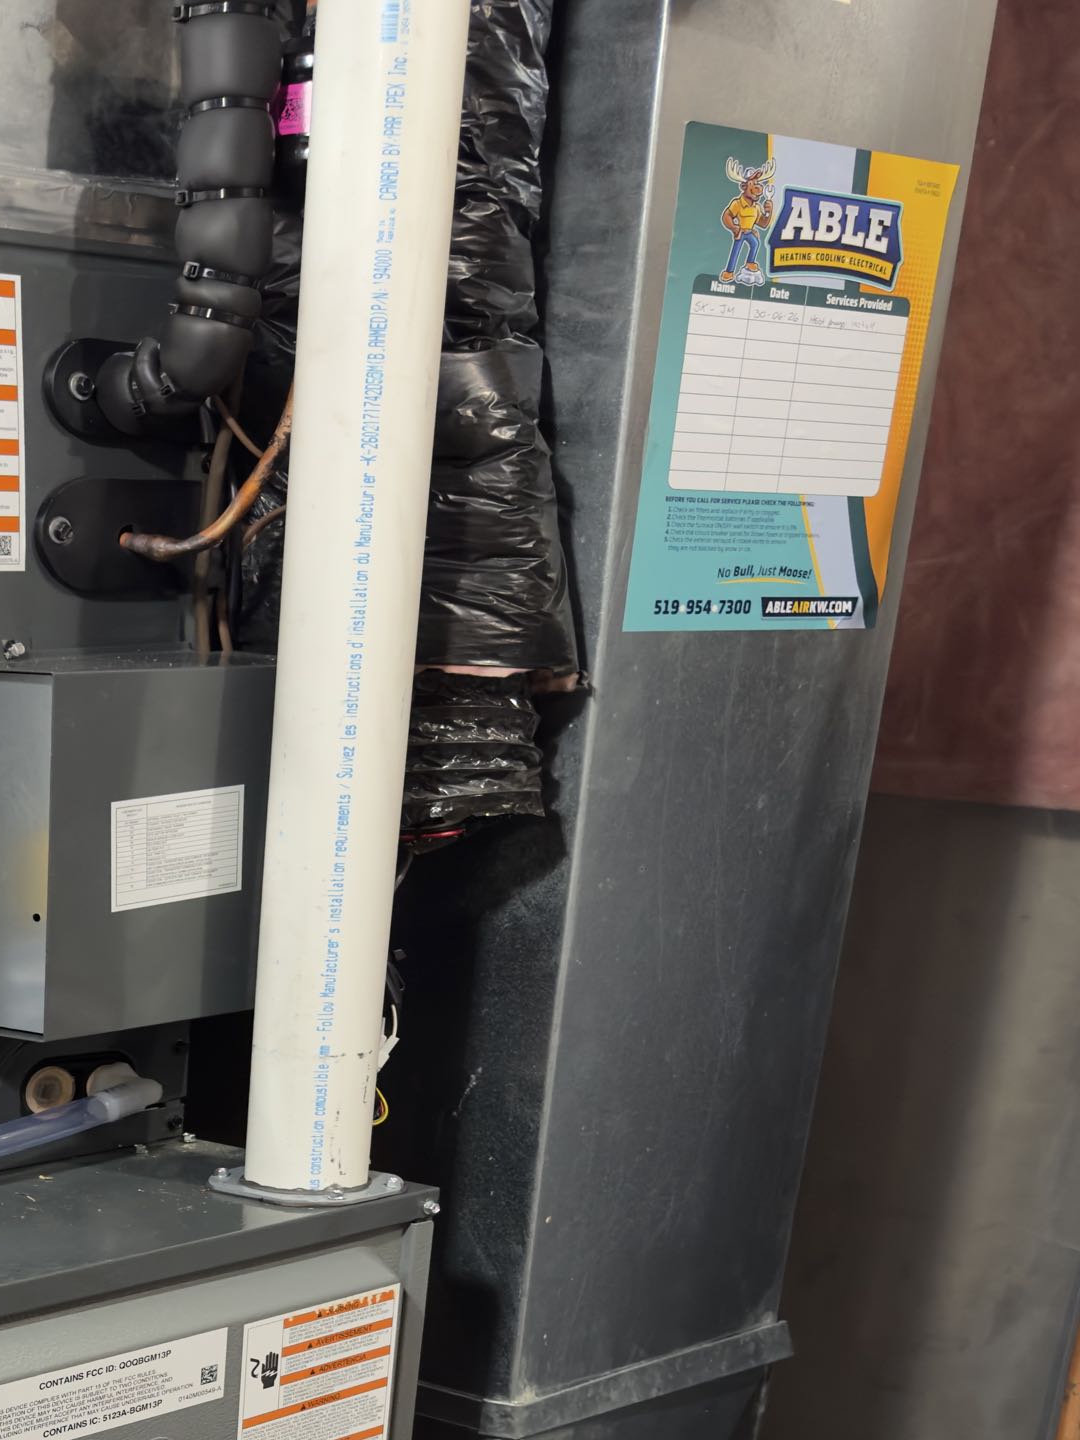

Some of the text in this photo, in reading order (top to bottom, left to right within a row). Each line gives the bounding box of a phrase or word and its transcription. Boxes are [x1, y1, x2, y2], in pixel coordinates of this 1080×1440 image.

[388, 51, 409, 76] Inc.
[384, 82, 406, 109] IPEX
[378, 161, 399, 201] CANADA
[780, 196, 893, 254] ABLE
[780, 252, 887, 275] HEATING COOLING ELECTRICAL
[710, 280, 892, 312] Name Date Services Provided
[354, 552, 370, 564] du
[718, 565, 812, 580] No Bull, Just Moose!
[766, 600, 852, 614] ABLEAIRKW.COM
[342, 654, 362, 718] instructions
[340, 724, 357, 740] les
[336, 746, 356, 778] Suivez
[332, 794, 351, 858] requirements
[326, 863, 346, 922] installation
[316, 1324, 373, 1346] AVERTISSEMENT
[39, 1350, 172, 1390] CONTAINS FCC ID: QOQBGM13P
[319, 1353, 366, 1373] ADVERTENCIA
[6, 1404, 28, 1414] DEVICE
[29, 1396, 60, 1407] COMPLIES
[61, 1390, 77, 1398] WITH
[78, 1386, 93, 1394] PART
[308, 1392, 340, 1408] WARNING
[43, 1399, 163, 1438] CONTAINS IC: 5123A-BGM13P
